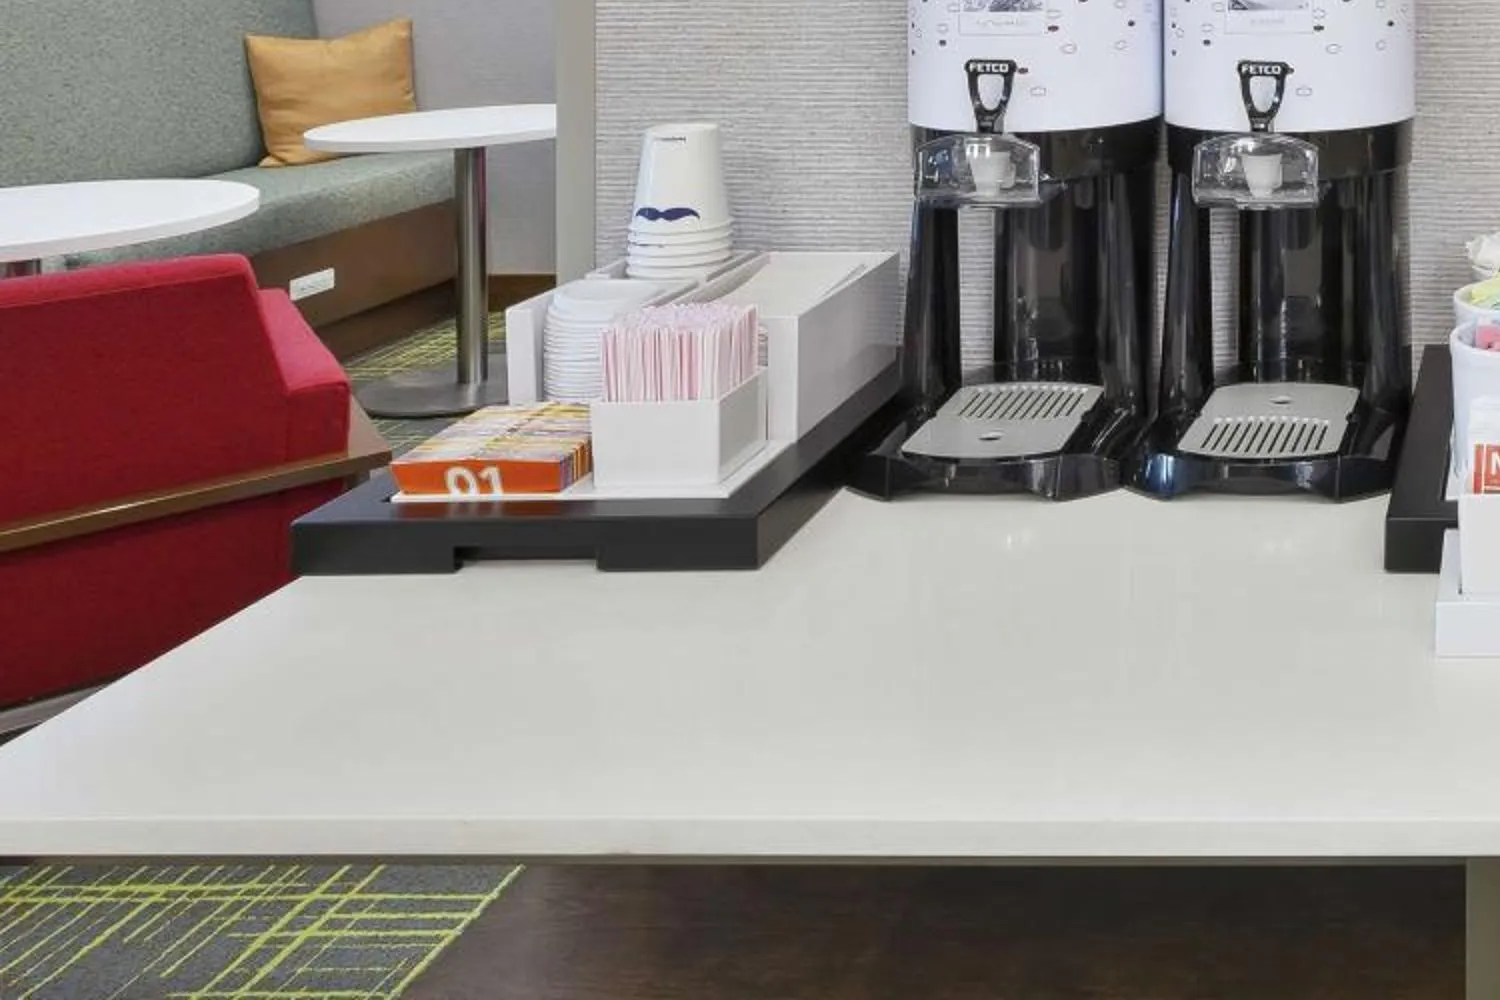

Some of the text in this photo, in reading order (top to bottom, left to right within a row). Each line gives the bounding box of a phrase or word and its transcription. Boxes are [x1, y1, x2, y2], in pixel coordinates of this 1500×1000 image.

[969, 62, 1009, 72] FETCO
[1241, 64, 1281, 75] FETCO
[445, 466, 504, 496] 01
